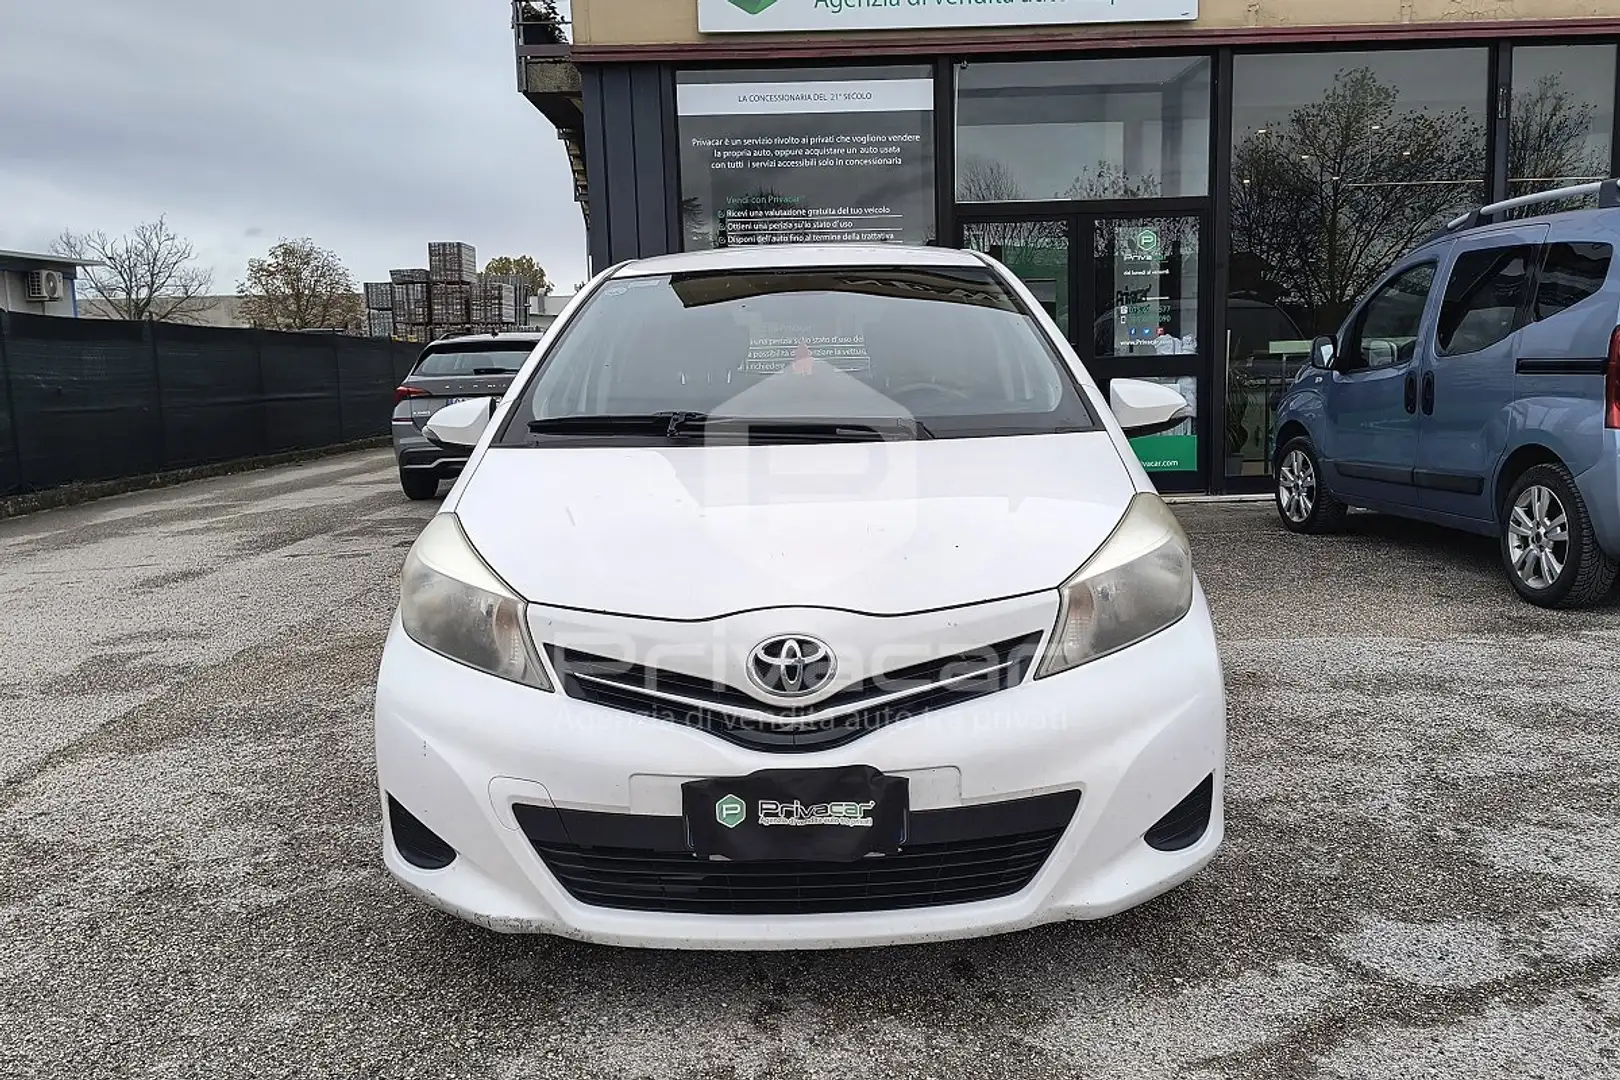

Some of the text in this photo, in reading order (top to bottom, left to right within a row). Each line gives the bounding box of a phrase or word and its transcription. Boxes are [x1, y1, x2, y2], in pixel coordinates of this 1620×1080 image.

[749, 93, 812, 103] CONCESSIONARIA
[813, 93, 827, 101] DEL
[843, 92, 872, 100] SECOLO
[692, 137, 723, 146] Privacar
[743, 136, 773, 146] servizio
[774, 136, 800, 145] rivolto
[801, 135, 809, 144] ai
[810, 135, 834, 145] privati
[836, 134, 851, 144] che
[852, 134, 886, 144] vogliono
[888, 133, 920, 142] vendere
[714, 149, 721, 158] la
[723, 149, 752, 159] propria
[775, 148, 803, 158] oppure
[804, 147, 845, 156] acquistare
[859, 146, 878, 154] auto
[711, 161, 726, 169] con
[727, 160, 744, 168] tutti
[751, 159, 776, 168] servizi
[777, 158, 817, 167] accessibili
[818, 158, 834, 166] solo
[835, 158, 844, 166] in
[845, 157, 902, 165] concessionaria
[726, 209, 748, 217] Ricevi
[764, 208, 806, 216] valutazione
[807, 207, 836, 216] gratuita
[837, 206, 849, 214] del
[864, 205, 891, 214] veicolo
[727, 222, 752, 230] Ottieni
[769, 221, 793, 231] perizia
[812, 220, 831, 228] stato
[727, 235, 756, 243] Disponi
[842, 232, 860, 240] della
[861, 232, 894, 240] trattativa
